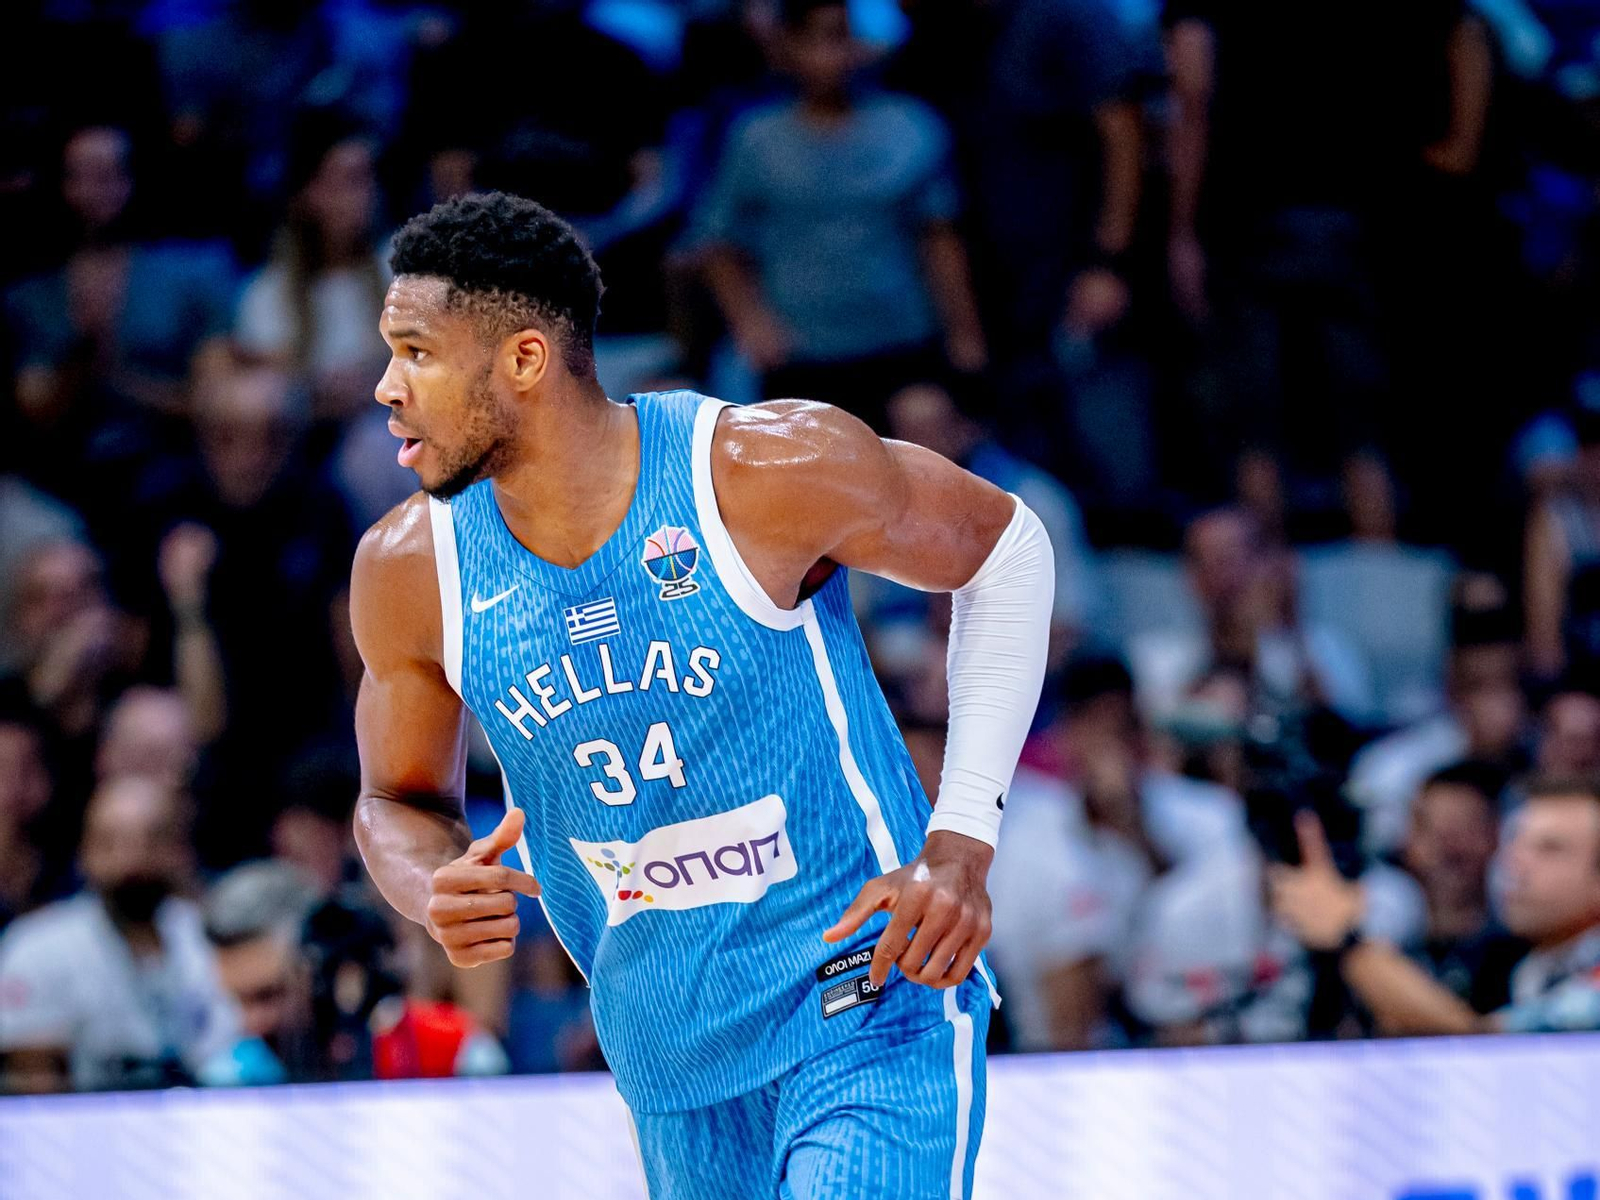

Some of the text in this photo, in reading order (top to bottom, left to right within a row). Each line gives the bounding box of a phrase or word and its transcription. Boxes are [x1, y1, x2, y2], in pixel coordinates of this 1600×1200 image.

[661, 576, 699, 599] 25
[494, 640, 721, 741] HELLAS
[572, 721, 687, 807] 34
